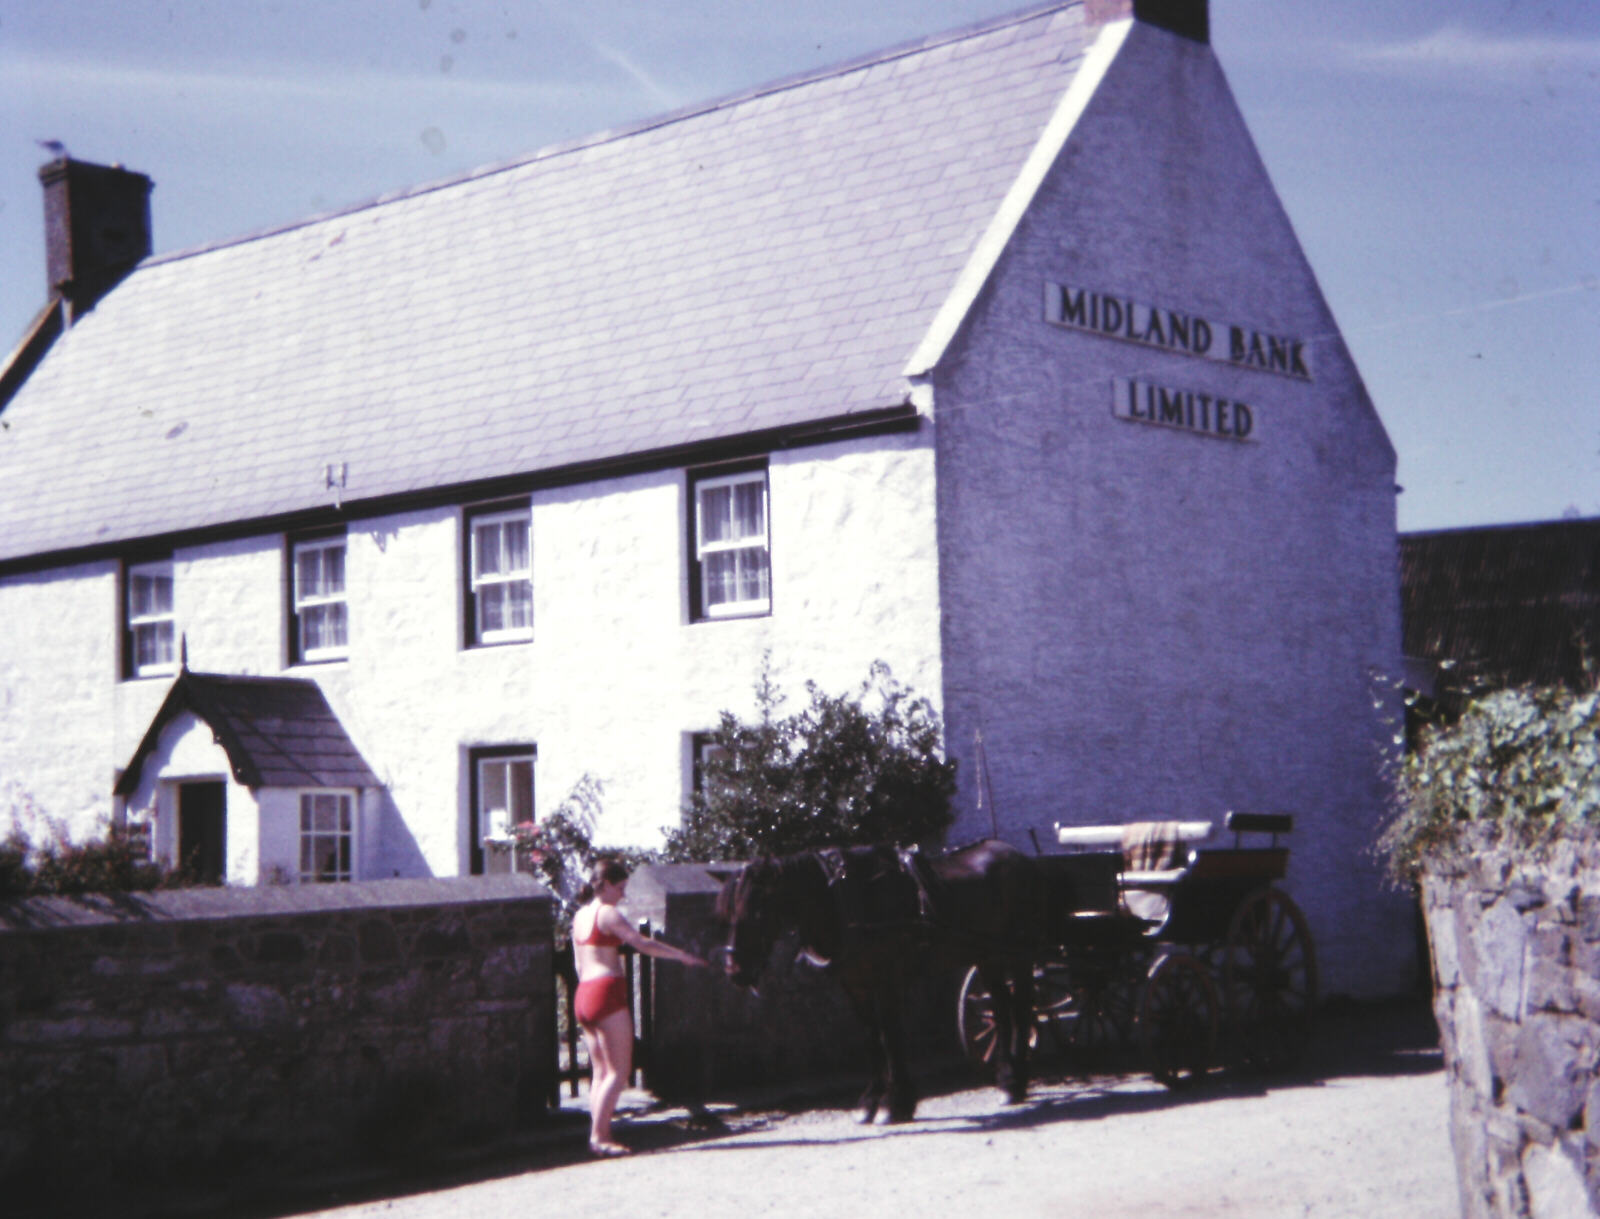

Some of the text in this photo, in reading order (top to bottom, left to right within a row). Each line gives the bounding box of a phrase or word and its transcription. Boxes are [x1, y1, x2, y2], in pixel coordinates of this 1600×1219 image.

[1060, 286, 1308, 377] MIDLAND BANK
[1129, 380, 1253, 438] LIMITED
